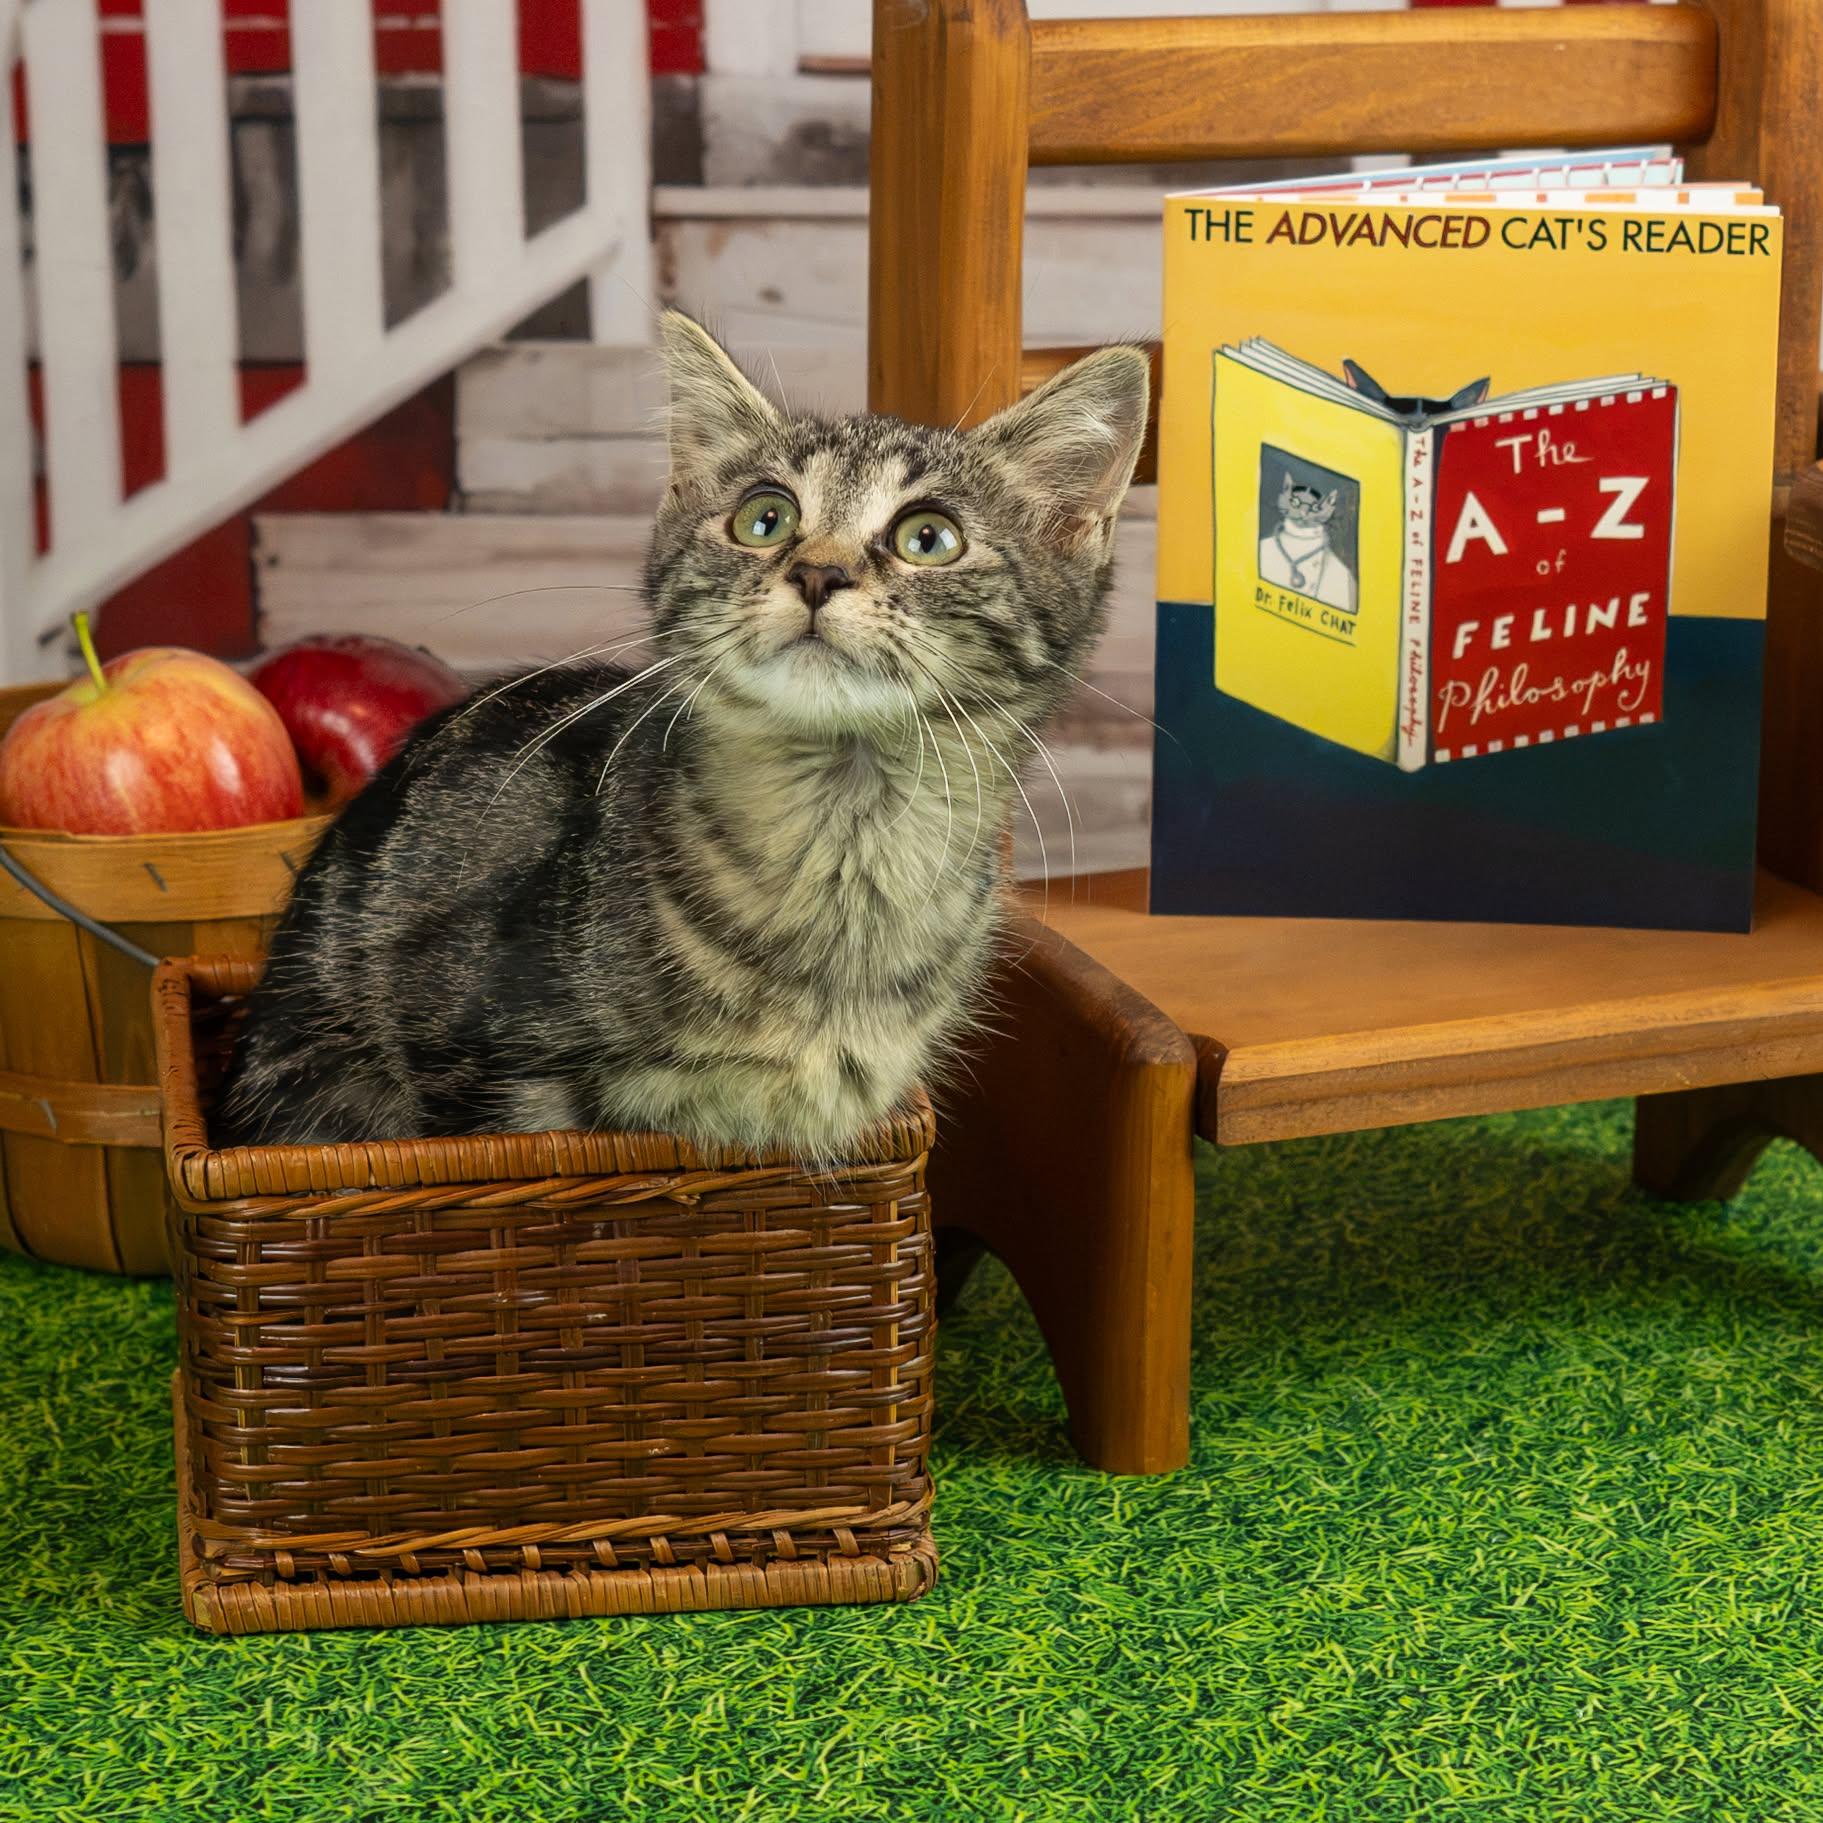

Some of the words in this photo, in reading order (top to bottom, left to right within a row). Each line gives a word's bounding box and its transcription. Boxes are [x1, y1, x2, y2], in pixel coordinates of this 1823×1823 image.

[1184, 208, 1254, 243] THE
[1266, 210, 1490, 249] ADVANCED
[1501, 216, 1607, 252] CAT'S
[1622, 220, 1771, 257] READER
[1412, 437, 1427, 467] The
[1495, 428, 1592, 474] The
[1446, 491, 1509, 564] A
[1590, 476, 1650, 540] Z
[1536, 549, 1566, 575] of
[1256, 587, 1273, 605] Dr.
[1278, 595, 1313, 618] Felix
[1320, 611, 1356, 635] CHAT
[1408, 559, 1424, 625] FELINE
[1452, 592, 1651, 659] FELINE
[1438, 647, 1651, 733] Philosophy
